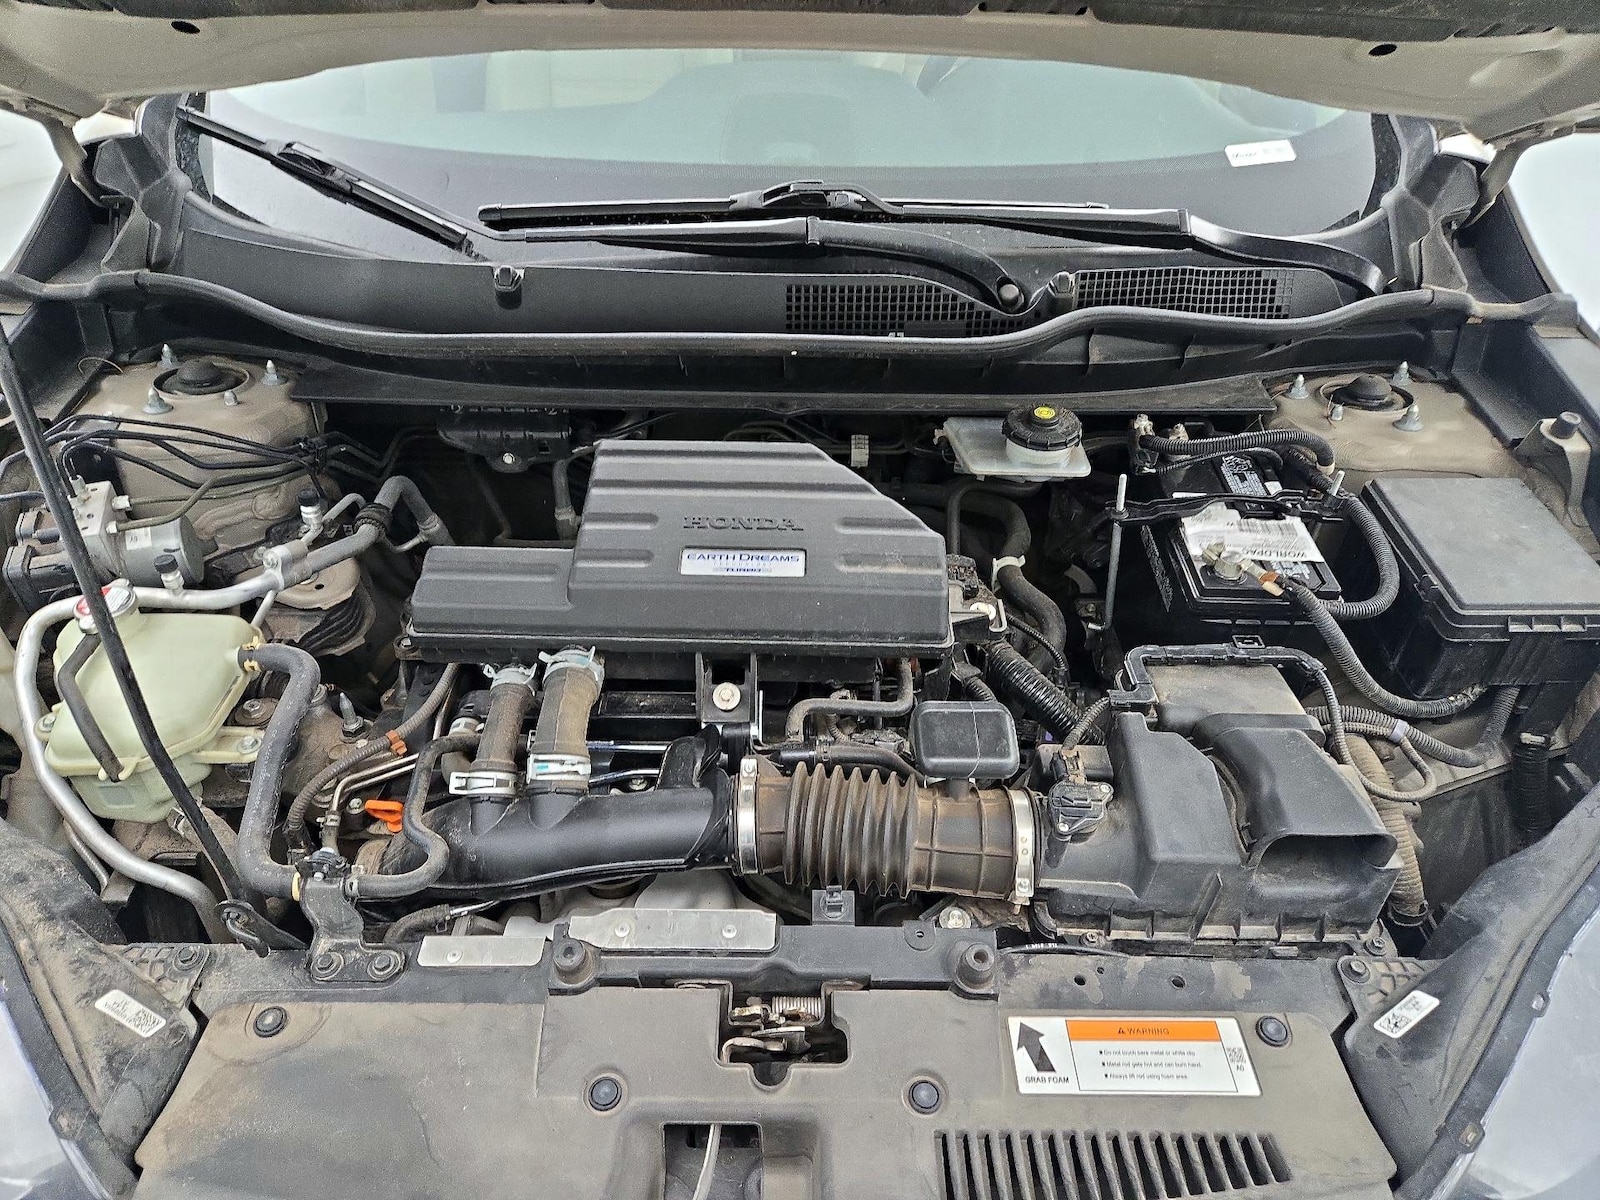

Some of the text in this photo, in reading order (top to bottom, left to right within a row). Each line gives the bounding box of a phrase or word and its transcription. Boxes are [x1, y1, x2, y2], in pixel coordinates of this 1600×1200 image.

[683, 516, 804, 531] HONDA
[687, 553, 800, 563] EARTH DREAMS
[1127, 1027, 1170, 1035] WARNING
[1025, 1076, 1070, 1084] GRAB FOAM
